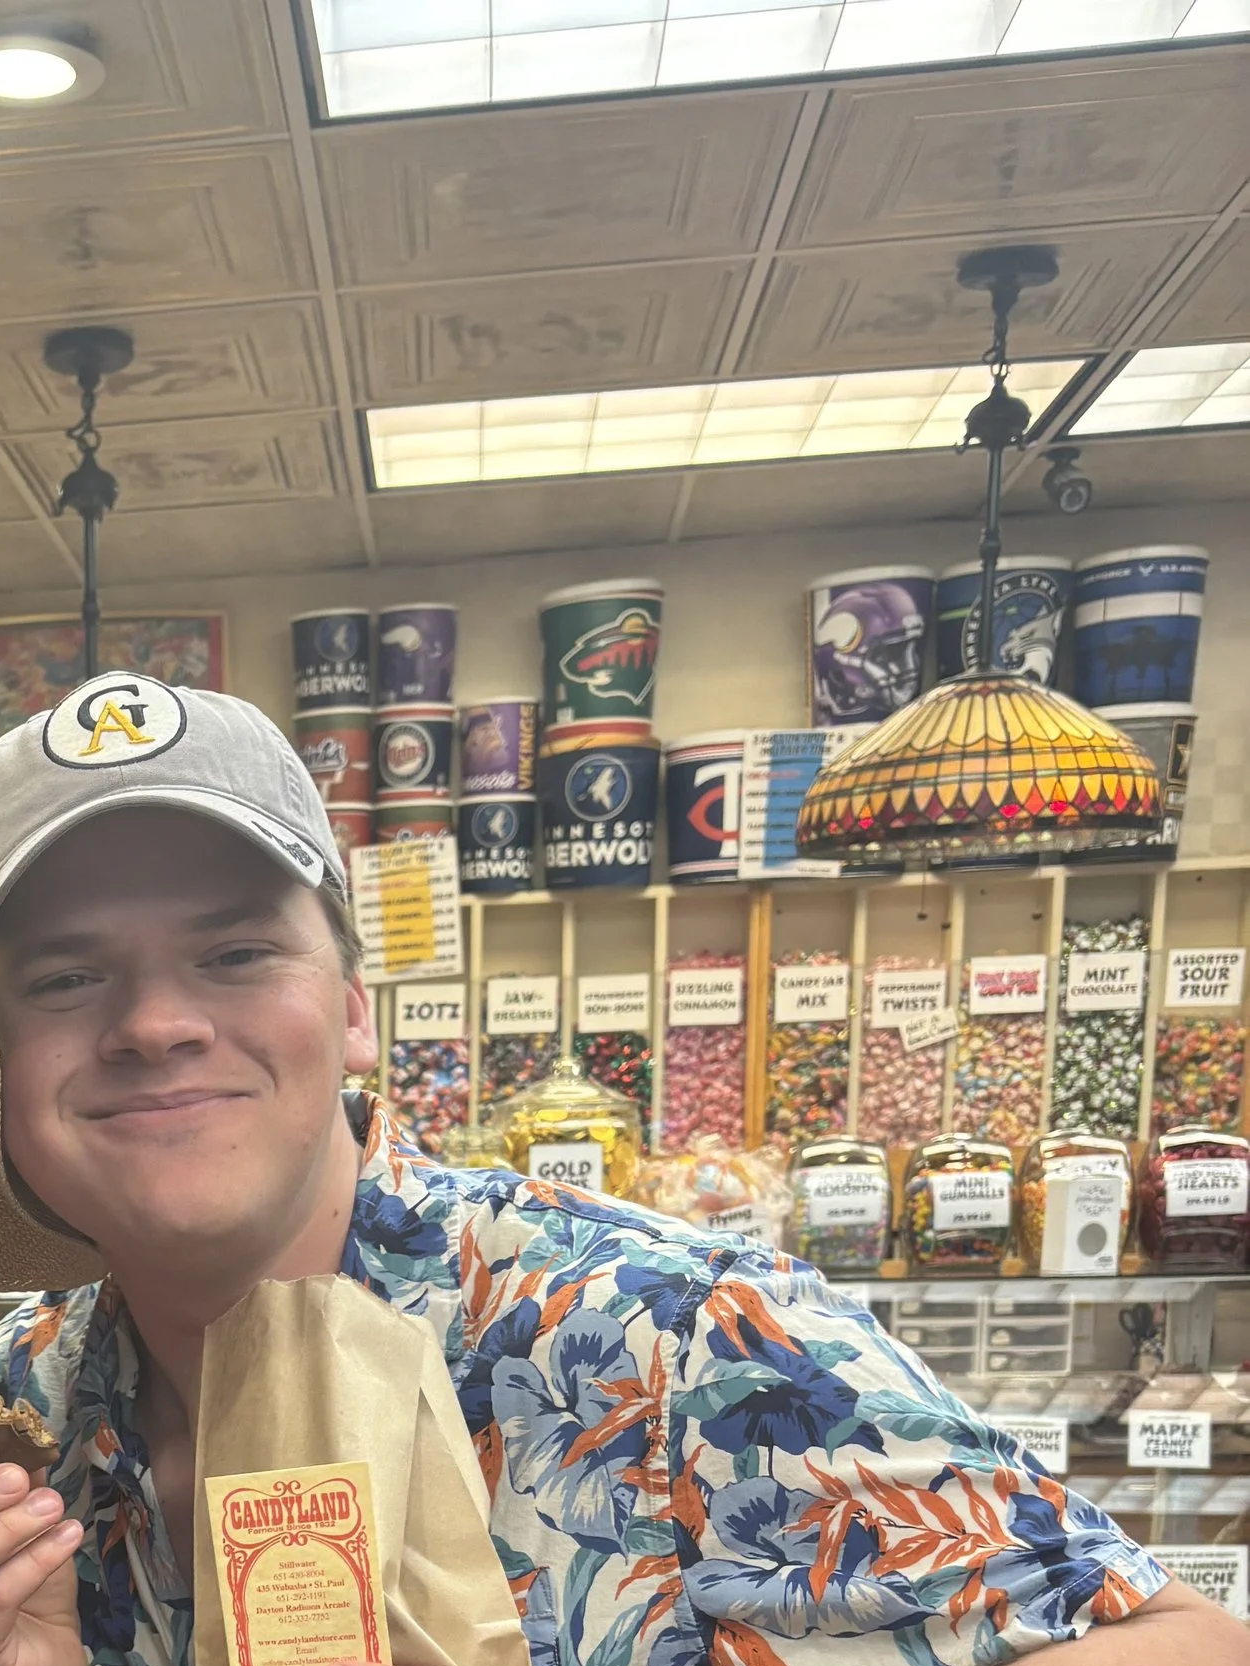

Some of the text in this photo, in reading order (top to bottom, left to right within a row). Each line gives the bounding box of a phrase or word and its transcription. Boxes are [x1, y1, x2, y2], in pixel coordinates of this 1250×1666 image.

[1174, 953, 1239, 966] ASSORTED
[1083, 967, 1130, 983] MINT
[1180, 967, 1230, 982] SOUR
[1070, 983, 1139, 996] CHOCOLATE
[1179, 983, 1230, 998] FRUIT
[796, 993, 828, 1009] MIX
[881, 998, 937, 1012] TWISTS
[403, 1002, 461, 1021] ZOTZ
[538, 1160, 591, 1178] GOLD
[954, 1176, 989, 1189] MINI
[1178, 1177, 1240, 1191] HEARTS
[940, 1188, 1005, 1201] GUMBALLS
[1004, 1428, 1063, 1441] OCONUT
[1139, 1423, 1203, 1438] MAPLE
[1145, 1437, 1193, 1448] PEANUT
[1144, 1448, 1193, 1459] CREMES
[230, 1491, 350, 1530] CANDYLAND
[248, 1526, 284, 1535] Famous
[286, 1523, 312, 1531] Since
[279, 1560, 317, 1570] Stillwater
[256, 1606, 284, 1616] Dayton
